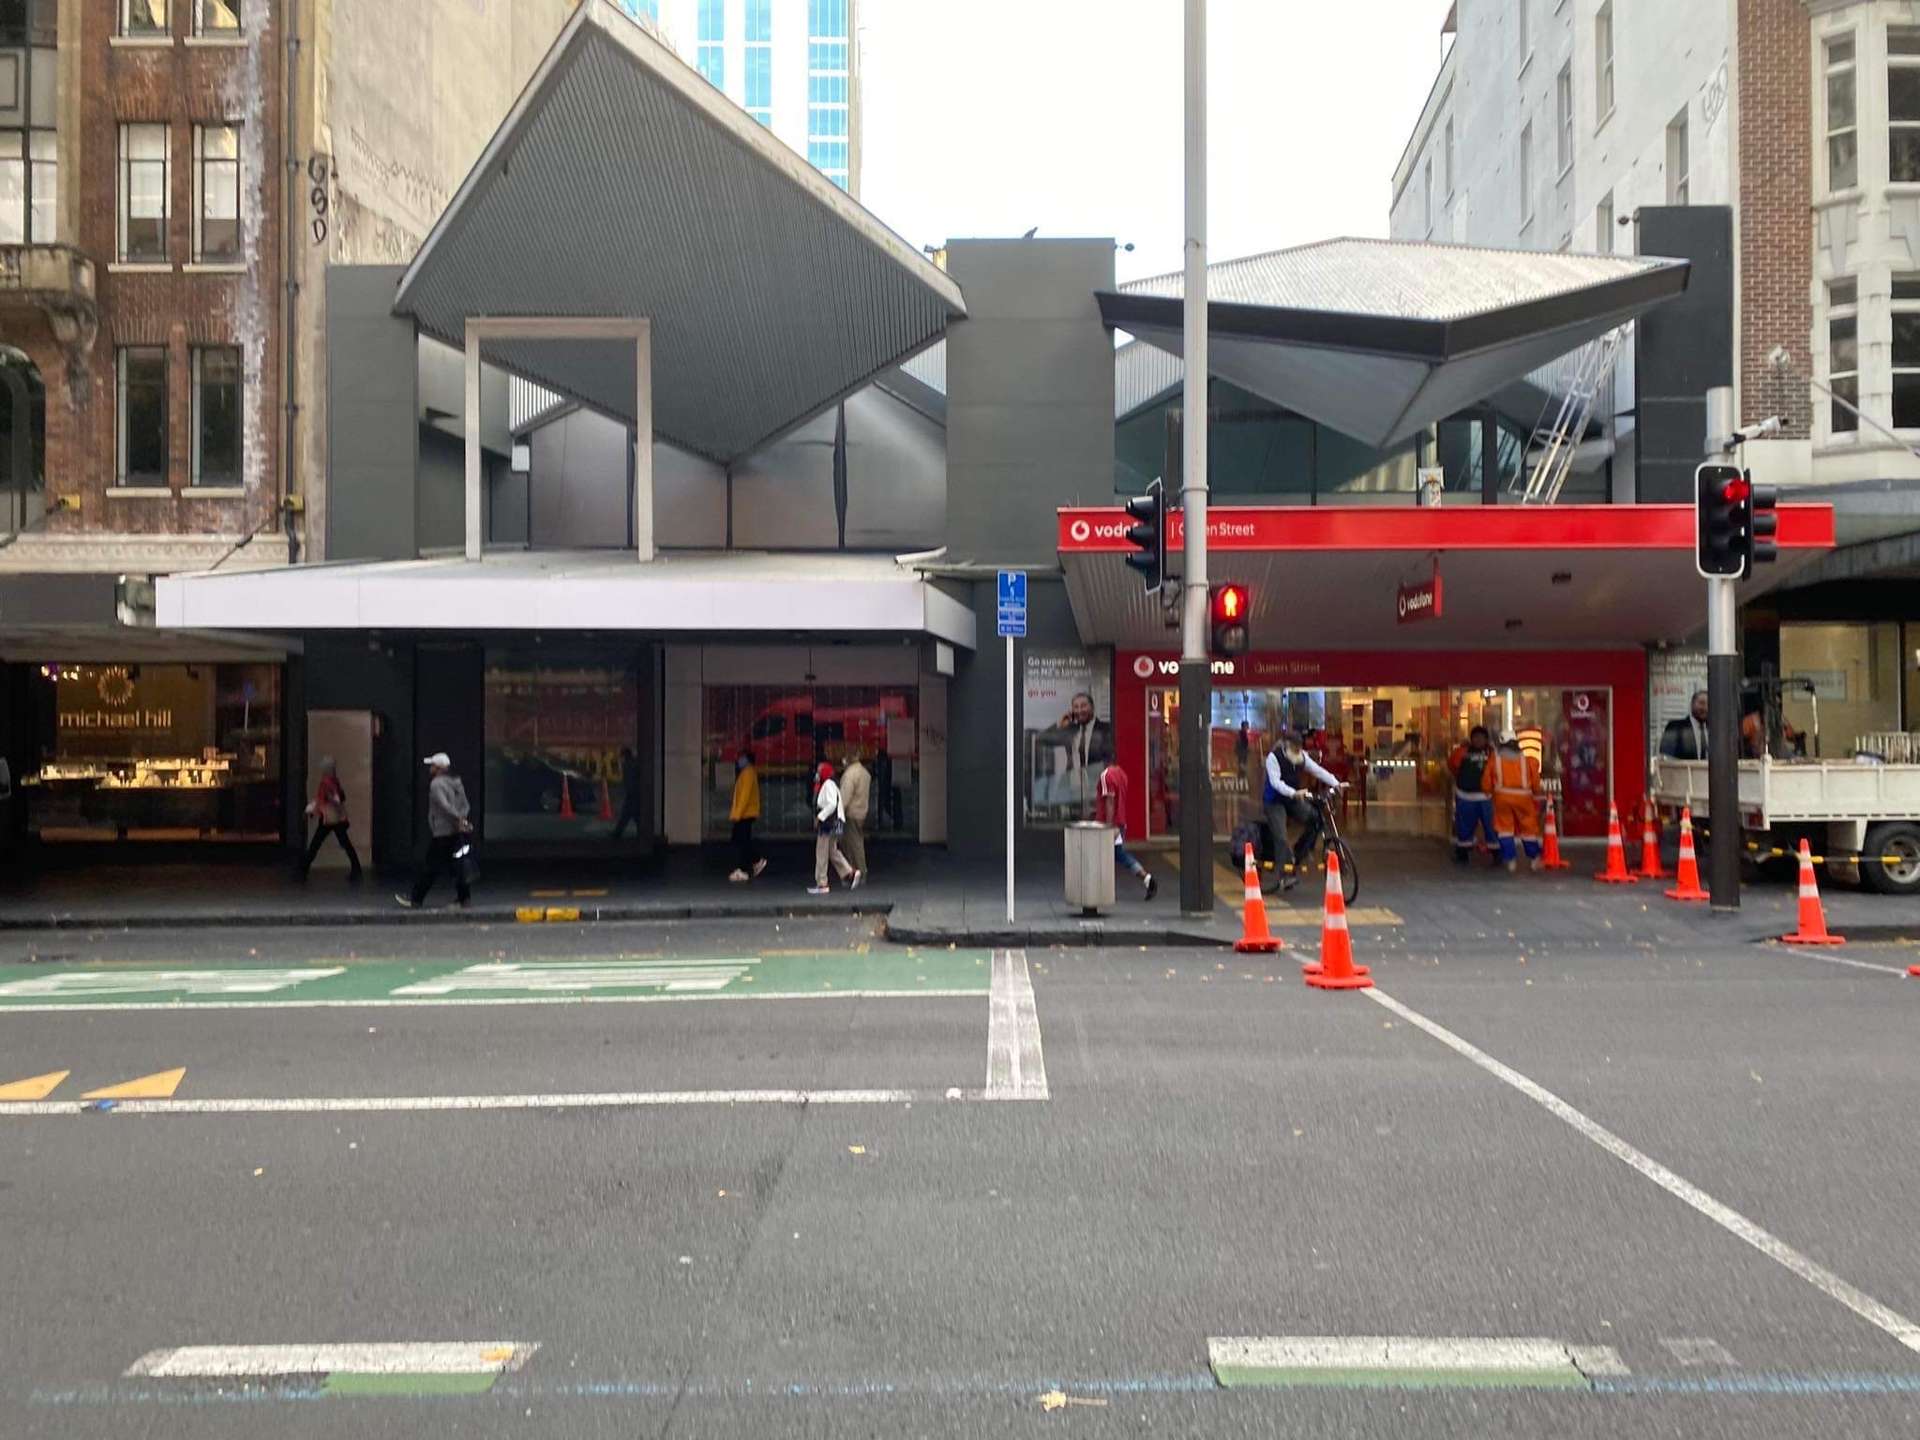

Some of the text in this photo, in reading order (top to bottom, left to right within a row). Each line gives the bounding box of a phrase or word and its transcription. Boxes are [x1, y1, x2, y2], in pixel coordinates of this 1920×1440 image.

[1219, 522, 1255, 537] Street
[1027, 656, 1040, 666] Go
[1256, 663, 1289, 674] Queen
[1290, 663, 1321, 673] Street
[60, 708, 172, 727] michael hill
